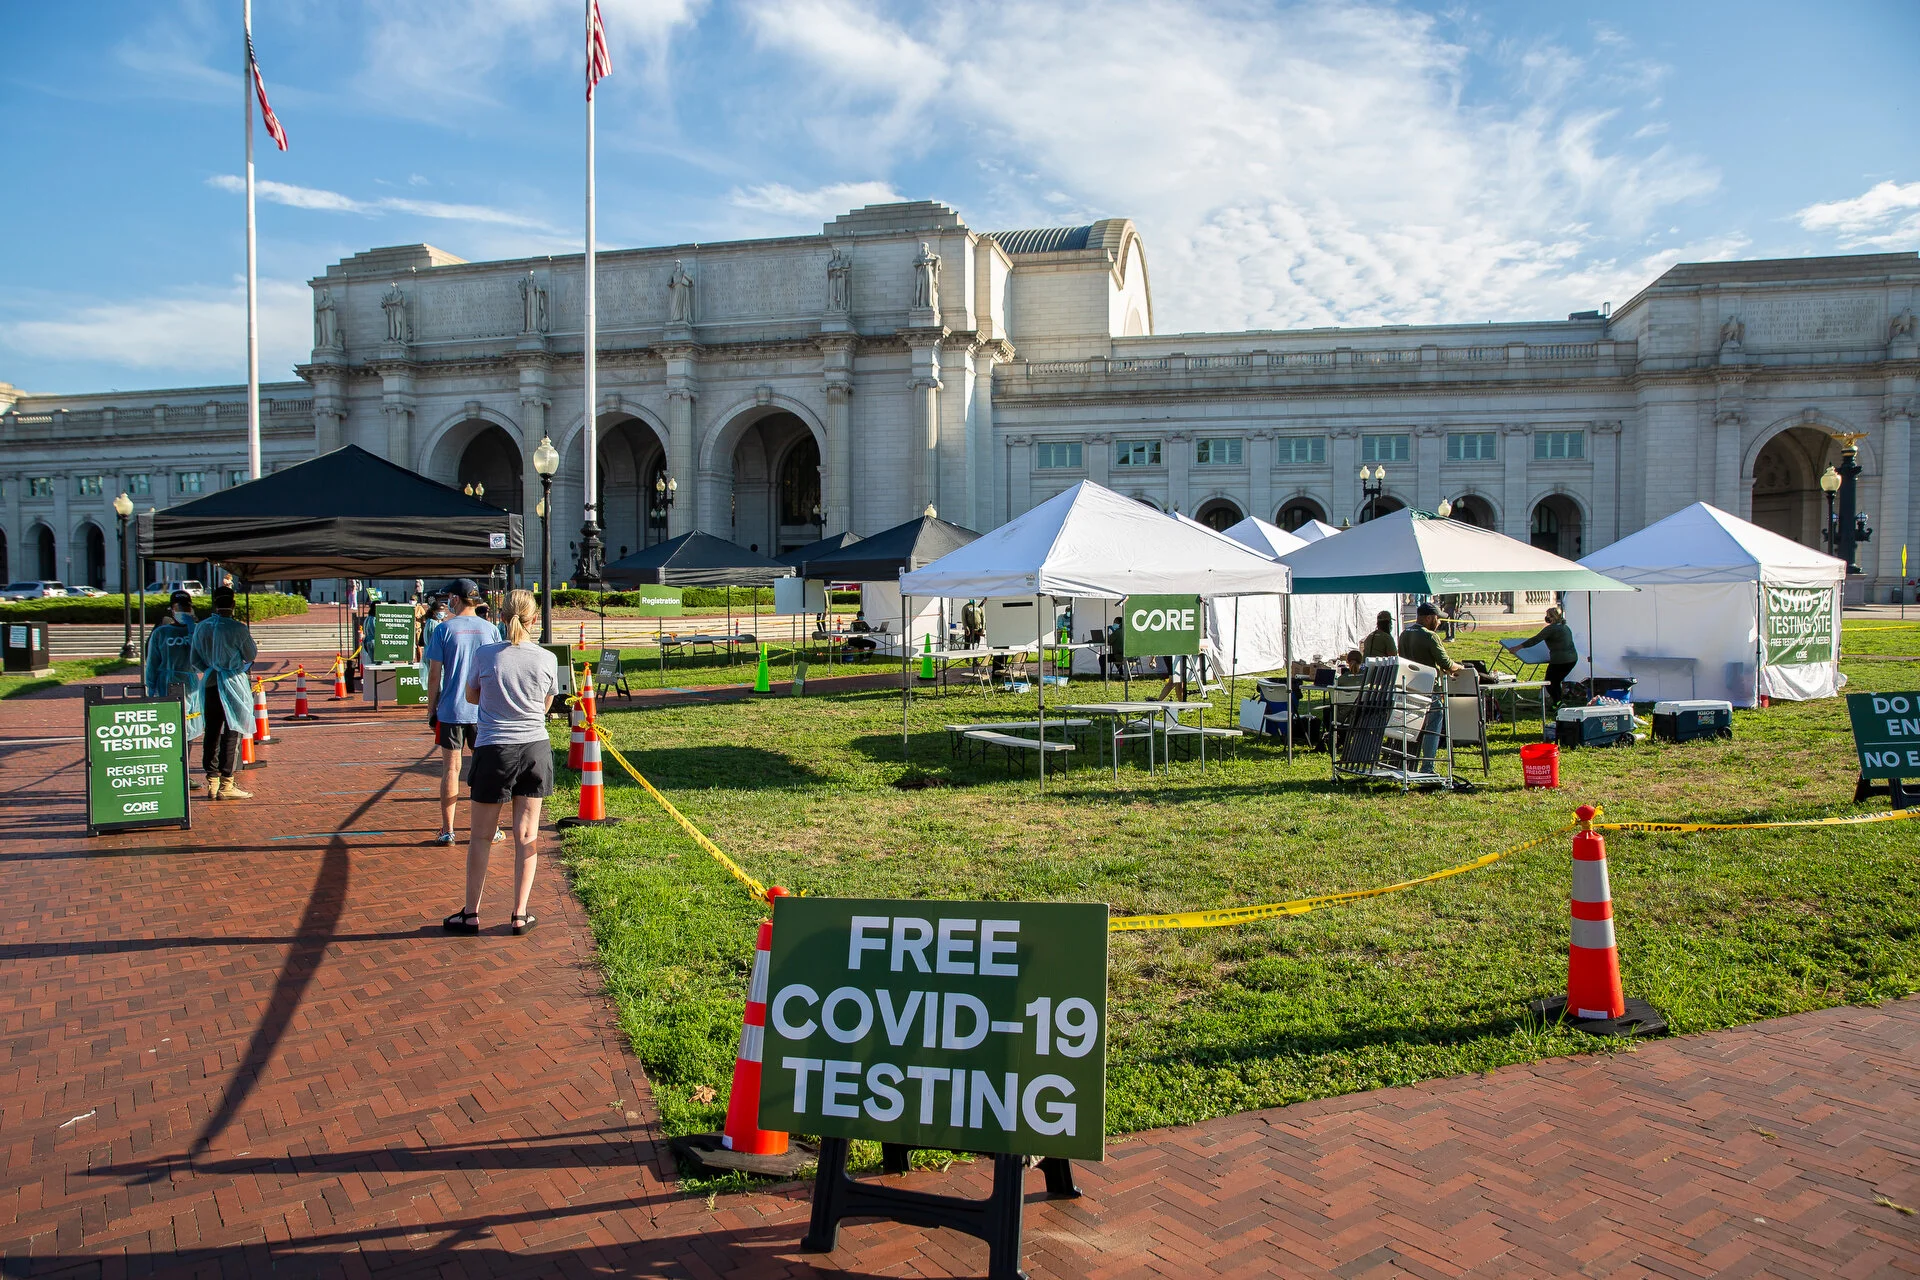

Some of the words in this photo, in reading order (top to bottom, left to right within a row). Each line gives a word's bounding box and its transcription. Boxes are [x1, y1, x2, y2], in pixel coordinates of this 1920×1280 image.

[641, 597, 681, 606] Registration
[1769, 588, 1833, 613] COVID-19
[1132, 609, 1195, 632] CORE
[1769, 616, 1812, 635] TESTING
[1813, 615, 1831, 634] SITE
[166, 636, 192, 646] COR
[1872, 696, 1910, 714] DO
[114, 709, 158, 724] FREE
[96, 722, 176, 739] COVID-19
[100, 736, 173, 752] TESTING
[1863, 751, 1900, 768] NO
[106, 763, 168, 777] REGISTER
[111, 775, 165, 789] ON-SITE
[122, 801, 159, 813] CORE
[847, 915, 1021, 977] FREE
[771, 983, 1099, 1058] COVID-19
[781, 1056, 1078, 1137] TESTING
